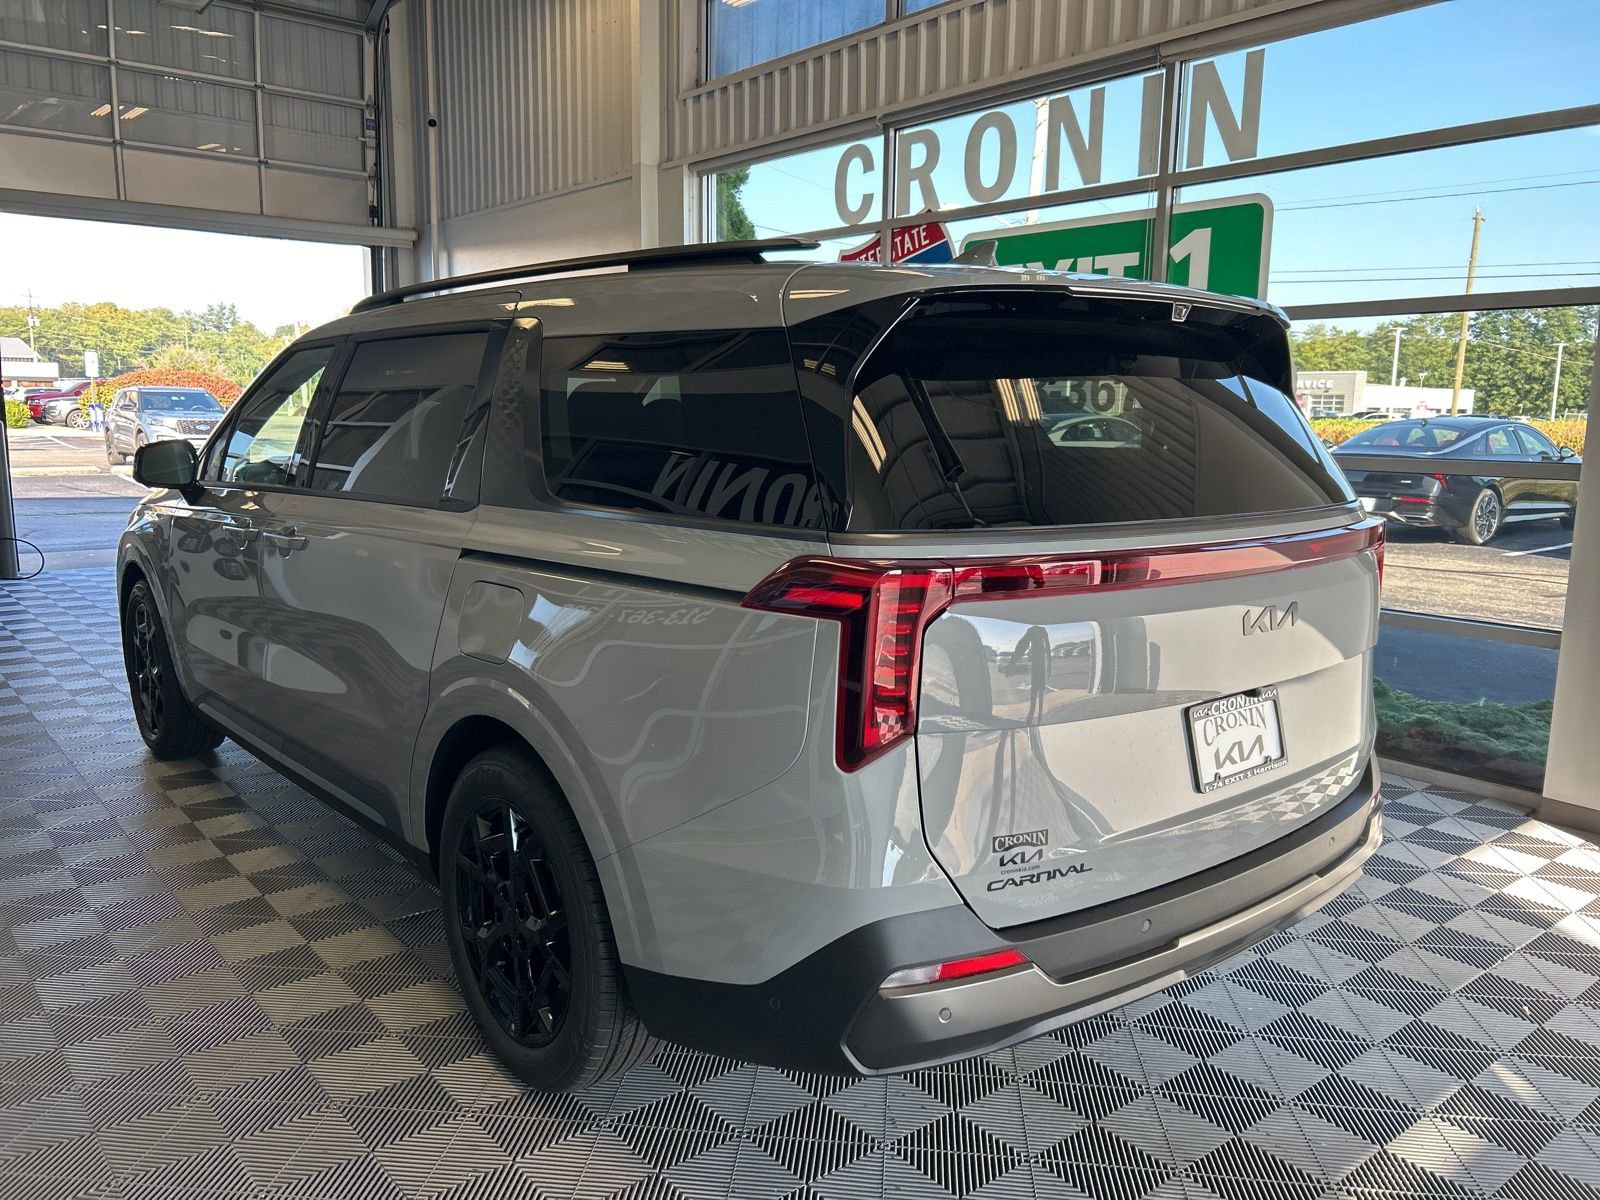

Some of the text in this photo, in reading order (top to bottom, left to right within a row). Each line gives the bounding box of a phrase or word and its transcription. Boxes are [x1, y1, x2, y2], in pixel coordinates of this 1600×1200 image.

[835, 48, 1265, 225] CRONIN
[1242, 600, 1298, 636] KIA
[1203, 704, 1267, 747] CRONIN
[1214, 734, 1264, 770] KIA
[1205, 782, 1223, 793] I-74
[1225, 775, 1244, 785] EXIT
[1254, 760, 1287, 775] Harrison
[994, 830, 1047, 852] CRONIN
[999, 848, 1043, 867] KIA
[987, 863, 1093, 892] CARNIVAL
[1001, 864, 1041, 875] croninkia.com
